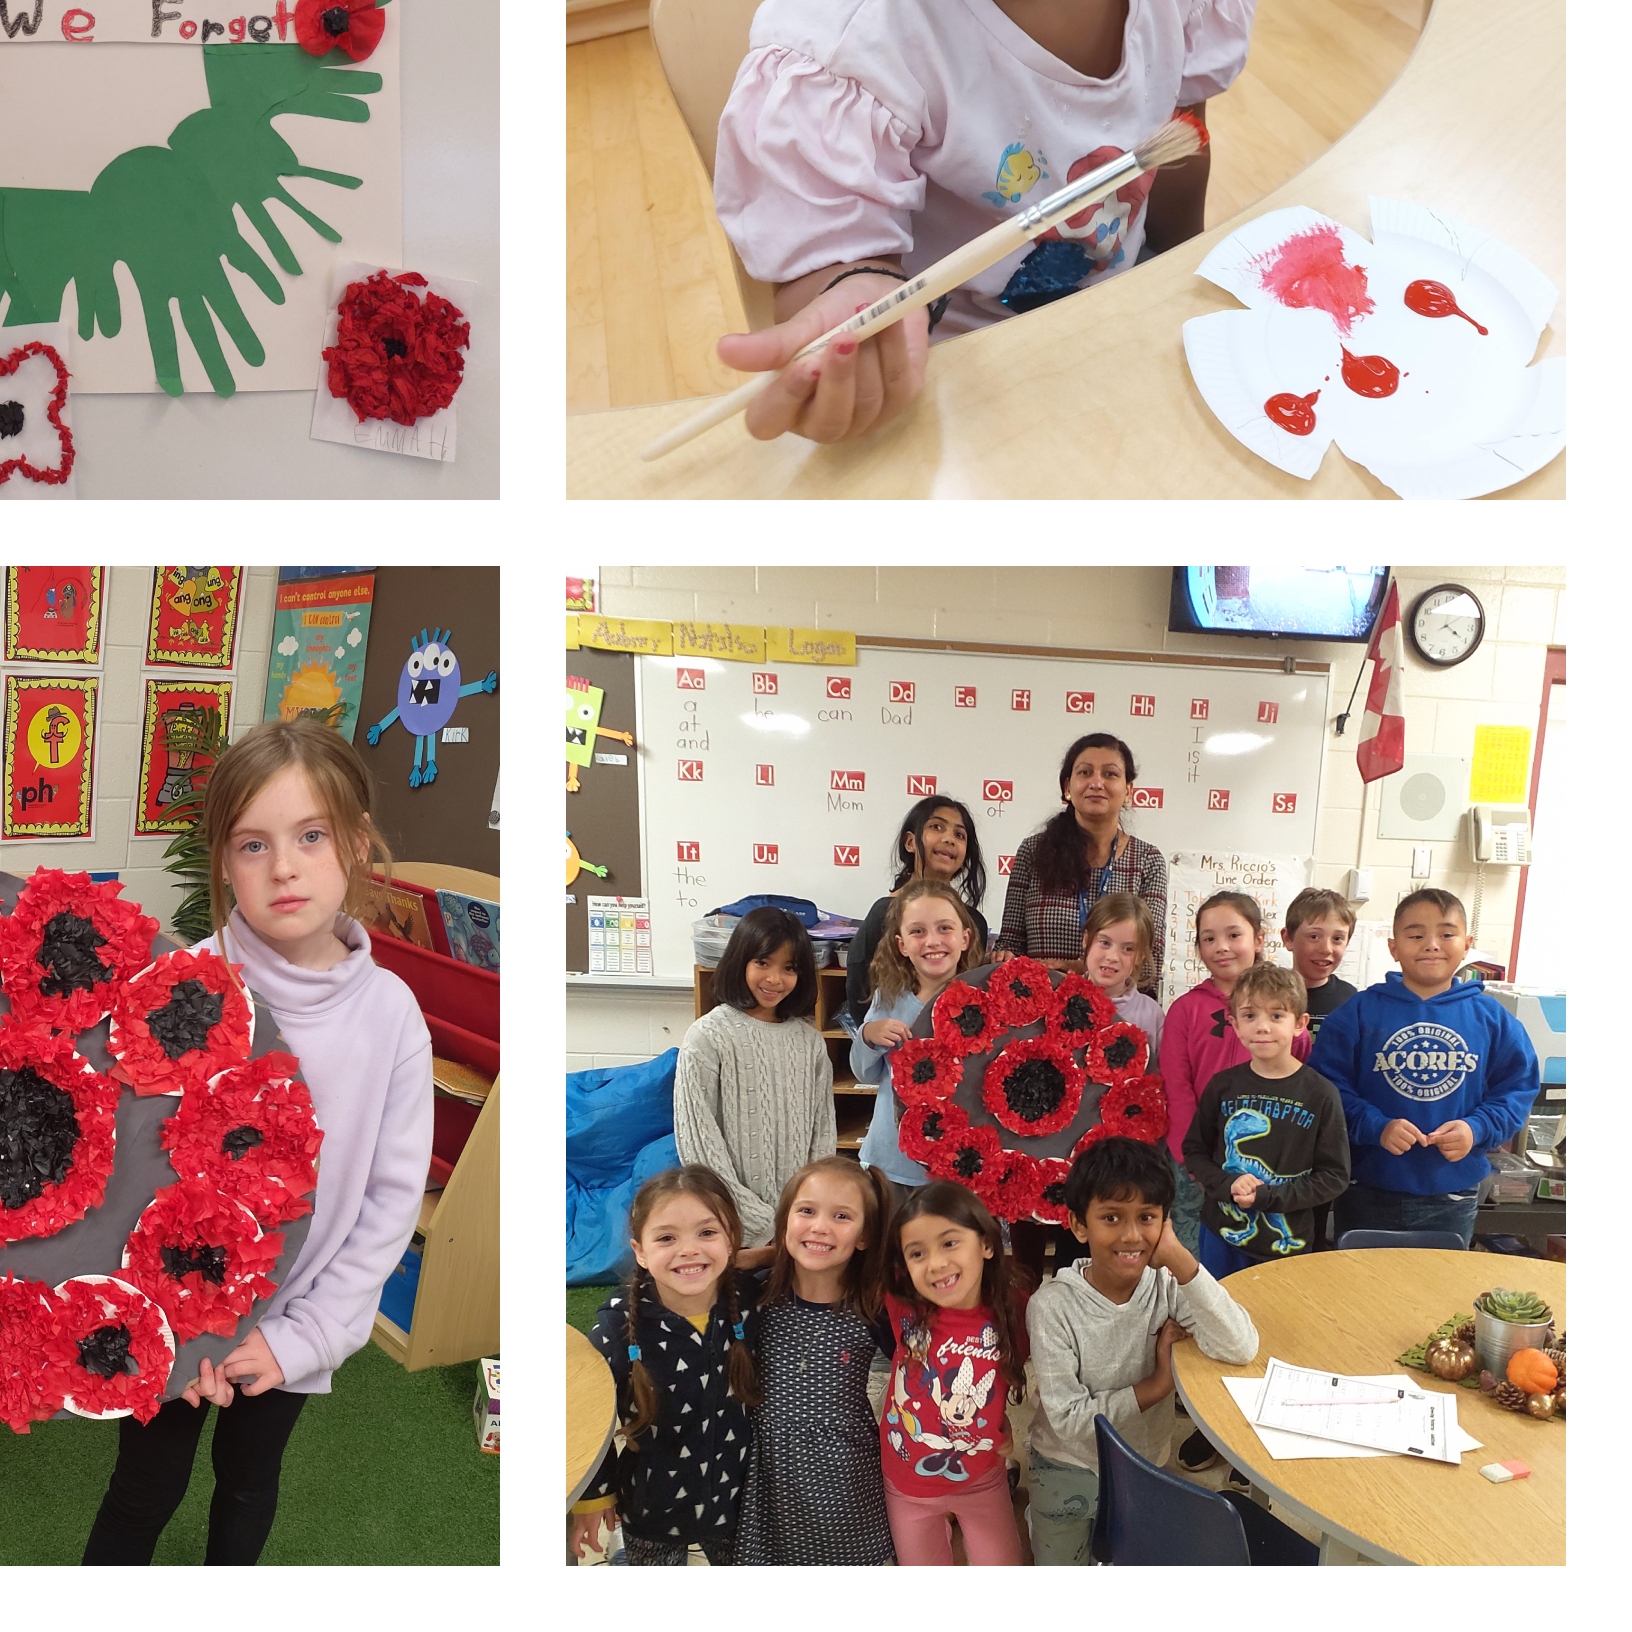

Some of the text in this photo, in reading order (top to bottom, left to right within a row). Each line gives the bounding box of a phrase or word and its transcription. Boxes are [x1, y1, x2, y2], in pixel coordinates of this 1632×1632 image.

[172, 569, 222, 588] ing ung
[173, 591, 212, 607] ang ong
[284, 585, 370, 604] can't control anyone else.
[306, 643, 332, 653] thoughts
[678, 670, 1275, 723] Aa Bb Cc Dd Ee Ff Gg Hh Ii Jj
[683, 700, 697, 713] a
[679, 714, 701, 732] at
[817, 706, 853, 722] can
[881, 706, 913, 726] Dad
[676, 730, 710, 751] and
[1187, 764, 1200, 783] it
[21, 777, 53, 811] ph
[679, 761, 1295, 813] Kk Ll Mm Nn Oo Qq Rr Ss
[827, 792, 864, 813] Mom
[986, 800, 1006, 818] of
[679, 842, 858, 864] Tt Uu Vv
[1231, 854, 1277, 872] Riccio's
[672, 866, 707, 886] the
[1215, 871, 1279, 886] Line Order
[385, 891, 419, 911] Thanks
[676, 890, 698, 908] to
[1391, 1026, 1461, 1047] 100% ORIGINAL
[1372, 1050, 1479, 1075] AÇORES
[1392, 1075, 1459, 1097] 100% ORIGINAL
[936, 1335, 1002, 1362] friends
